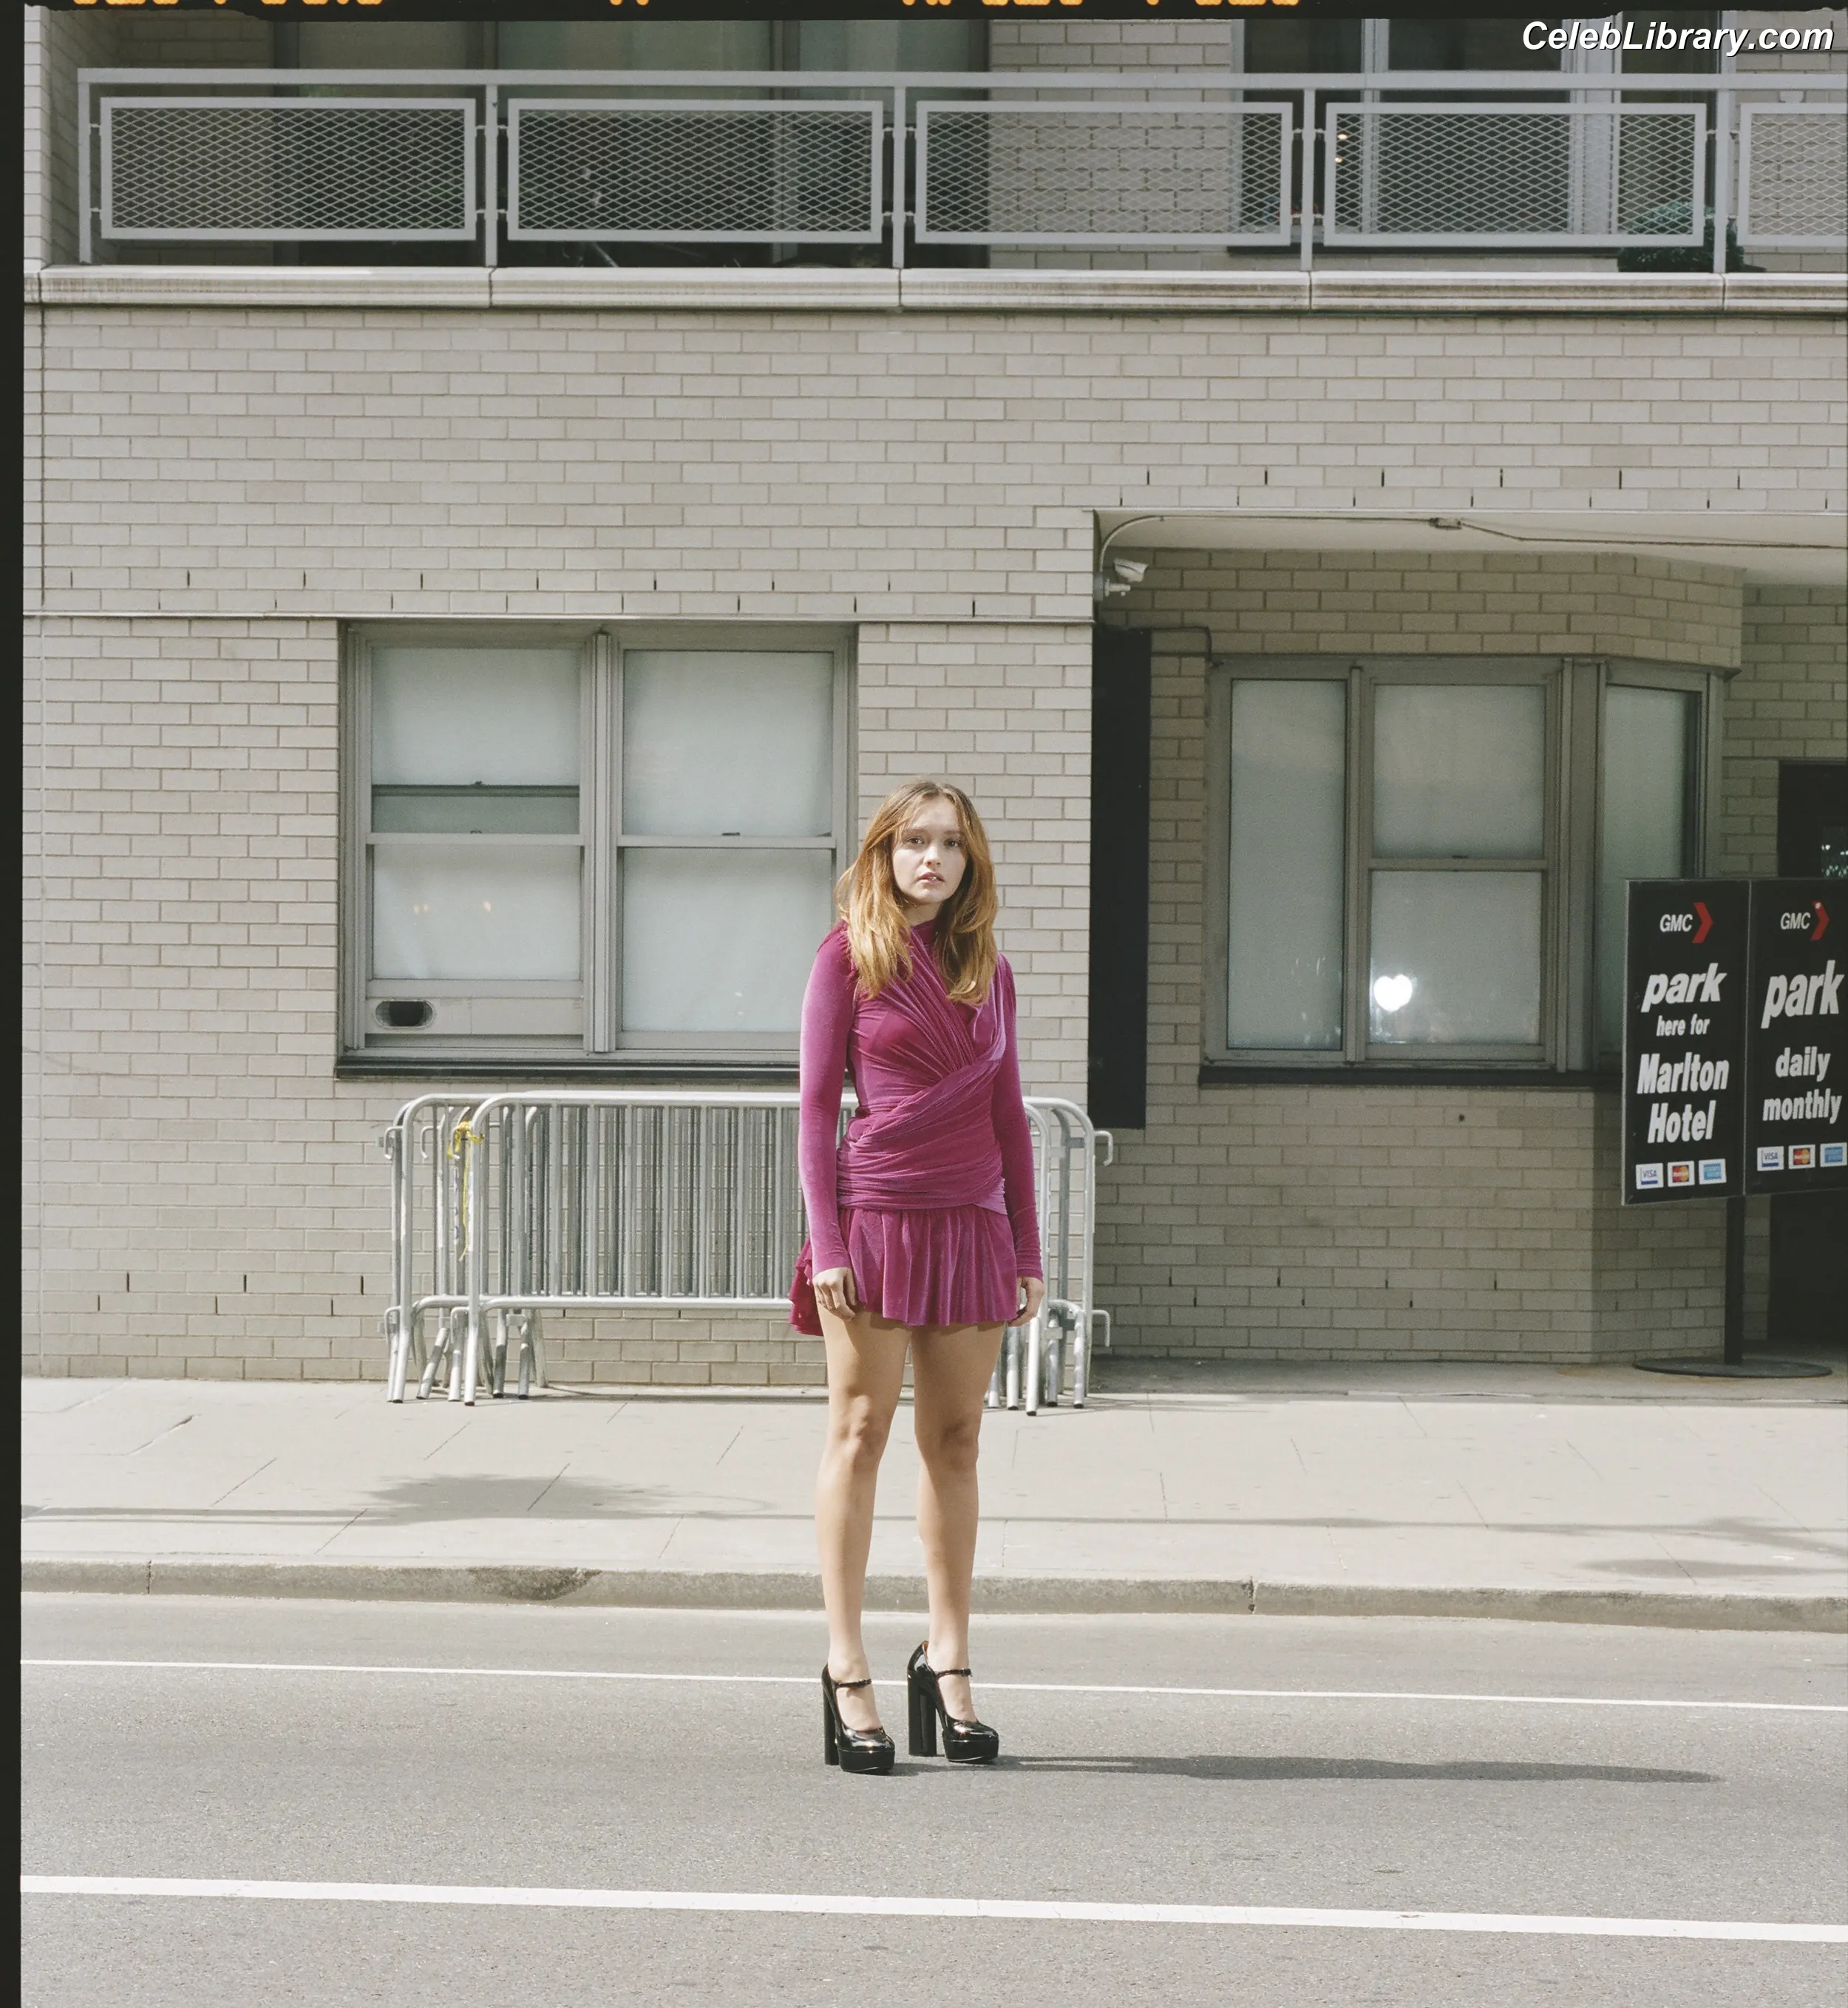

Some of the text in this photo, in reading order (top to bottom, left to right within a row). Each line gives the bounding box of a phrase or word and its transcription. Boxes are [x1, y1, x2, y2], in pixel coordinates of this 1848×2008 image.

[1660, 914, 1693, 932] GMC
[1780, 912, 1810, 929] GMC
[1640, 963, 1728, 1012] park
[1761, 960, 1845, 1028] park
[1656, 1014, 1711, 1036] here for
[1637, 1051, 1729, 1094] Marlton
[1776, 1046, 1831, 1082] daily
[1647, 1100, 1716, 1144] Hotel
[1762, 1088, 1842, 1125] monthly
[1643, 1170, 1657, 1178] VISA
